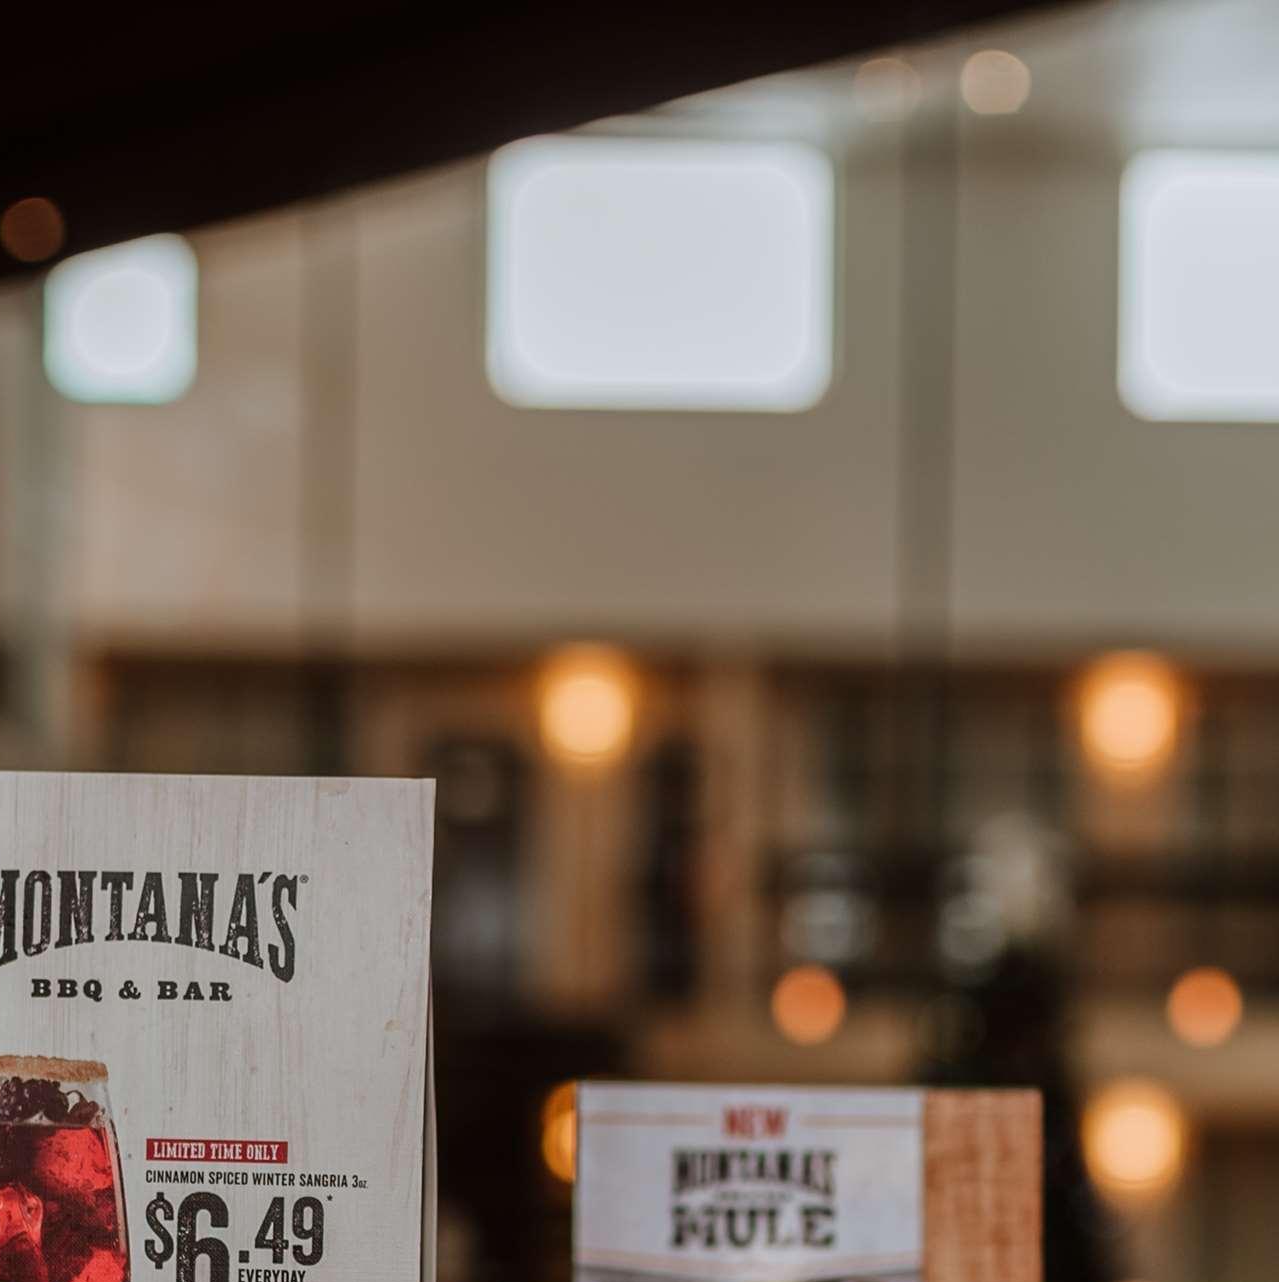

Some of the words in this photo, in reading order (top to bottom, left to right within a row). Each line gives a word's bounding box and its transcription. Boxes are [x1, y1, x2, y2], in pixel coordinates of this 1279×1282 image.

[30, 978, 103, 1002] BBQ
[118, 980, 141, 1000] &
[157, 980, 233, 1002] BAR
[153, 1141, 206, 1159] LIMITED
[210, 1143, 243, 1160] TIME
[246, 1144, 280, 1161] ONLY
[145, 1169, 205, 1185] CINNAMON
[208, 1171, 249, 1186] SPICED
[252, 1172, 296, 1187] WINTER
[299, 1173, 348, 1188] SANGRIA
